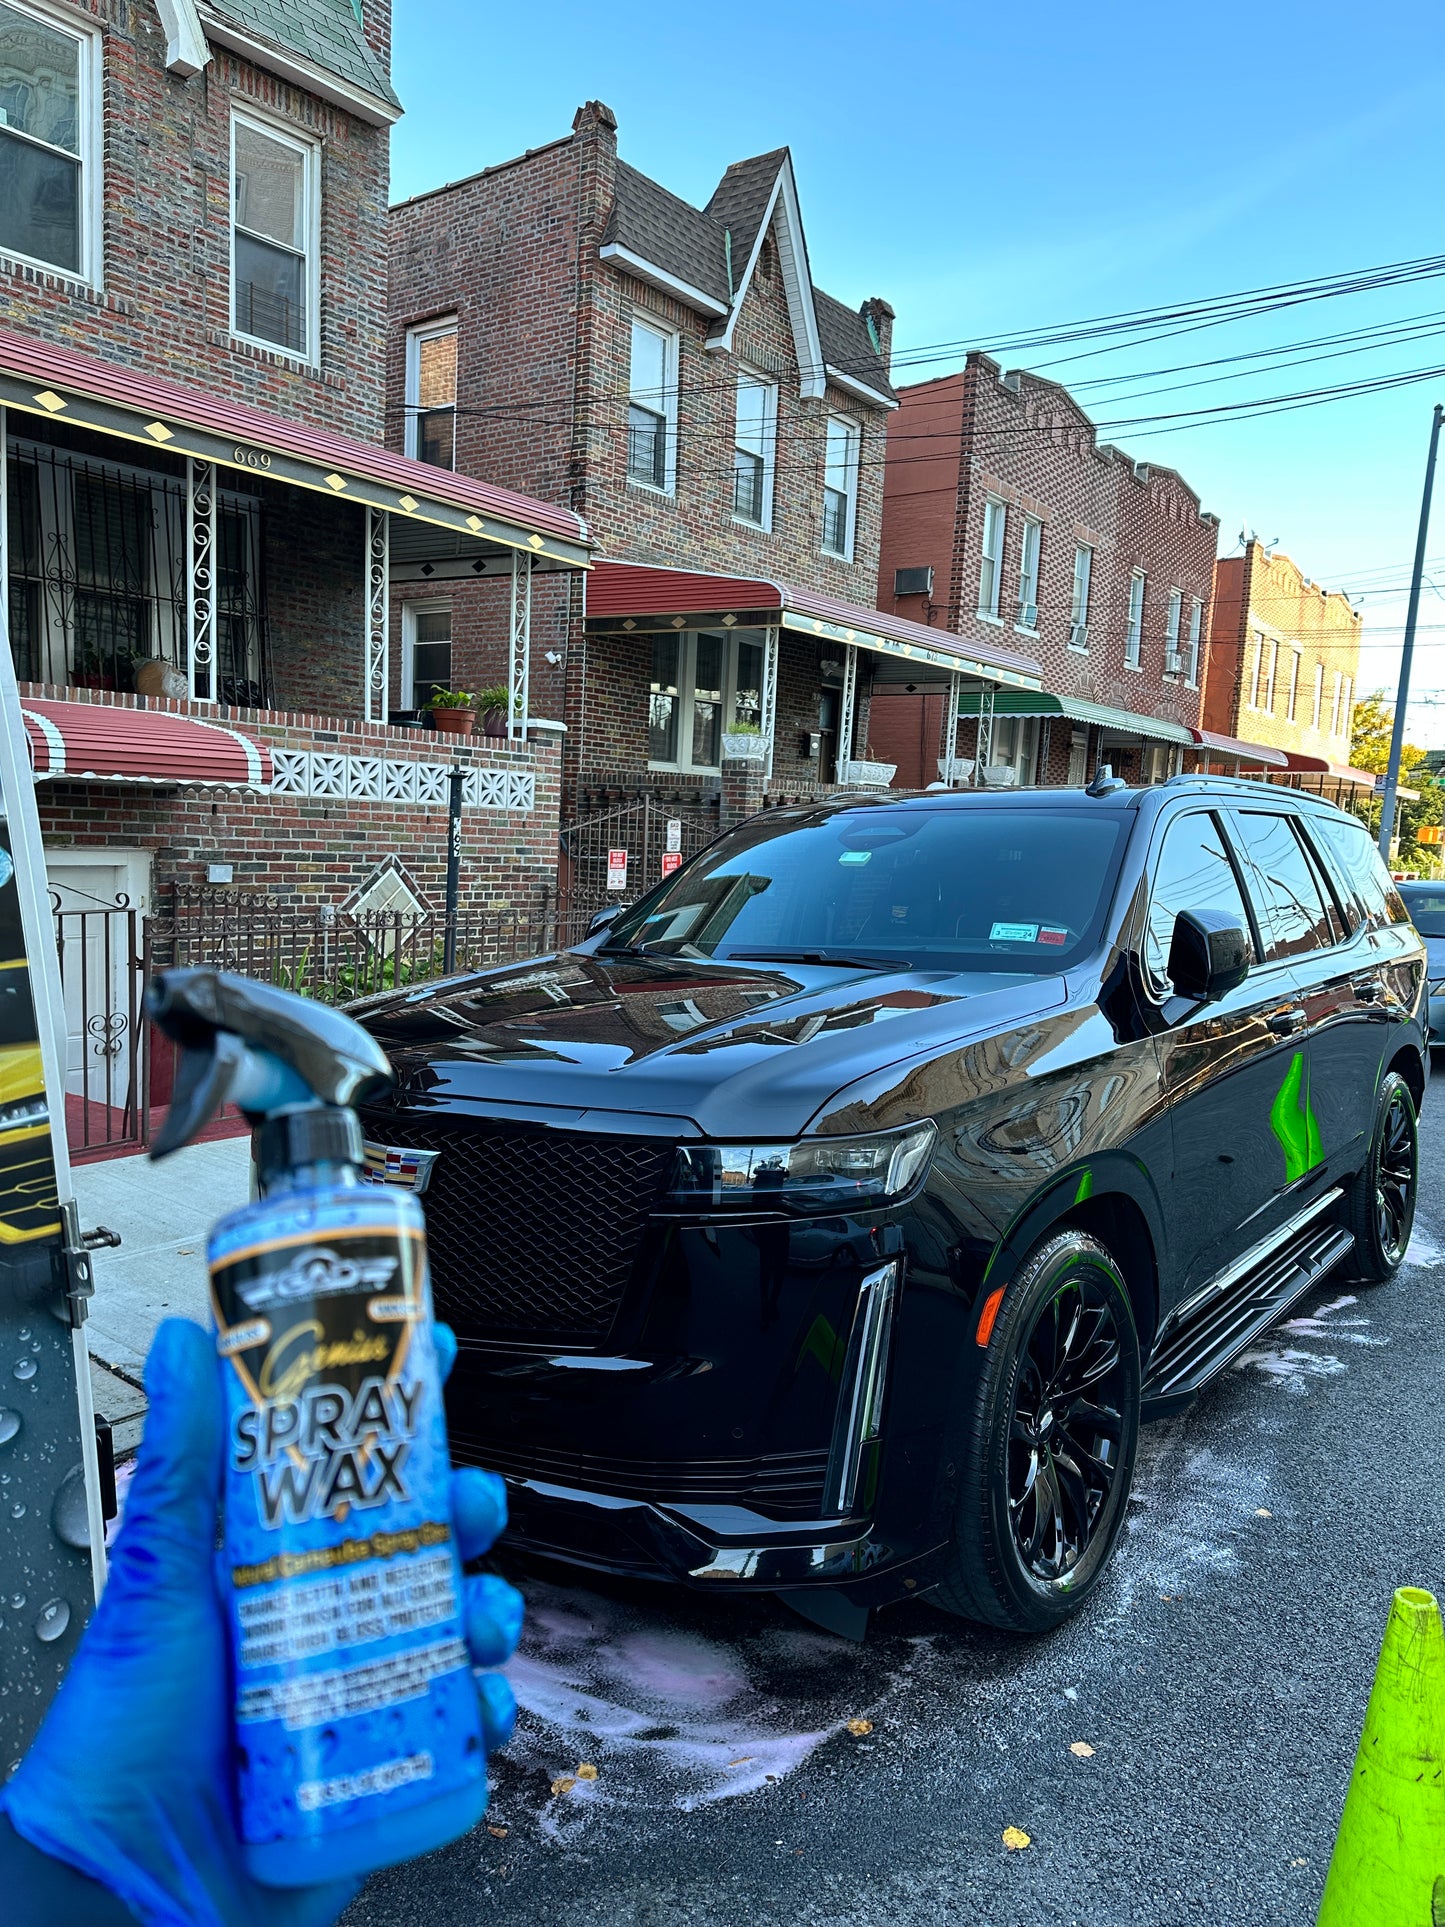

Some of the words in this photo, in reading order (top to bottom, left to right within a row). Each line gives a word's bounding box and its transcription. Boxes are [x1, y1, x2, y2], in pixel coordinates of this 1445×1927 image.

[234, 446, 271, 470] 669
[232, 1376, 424, 1471] SPRAY
[253, 1442, 412, 1530] WAX
